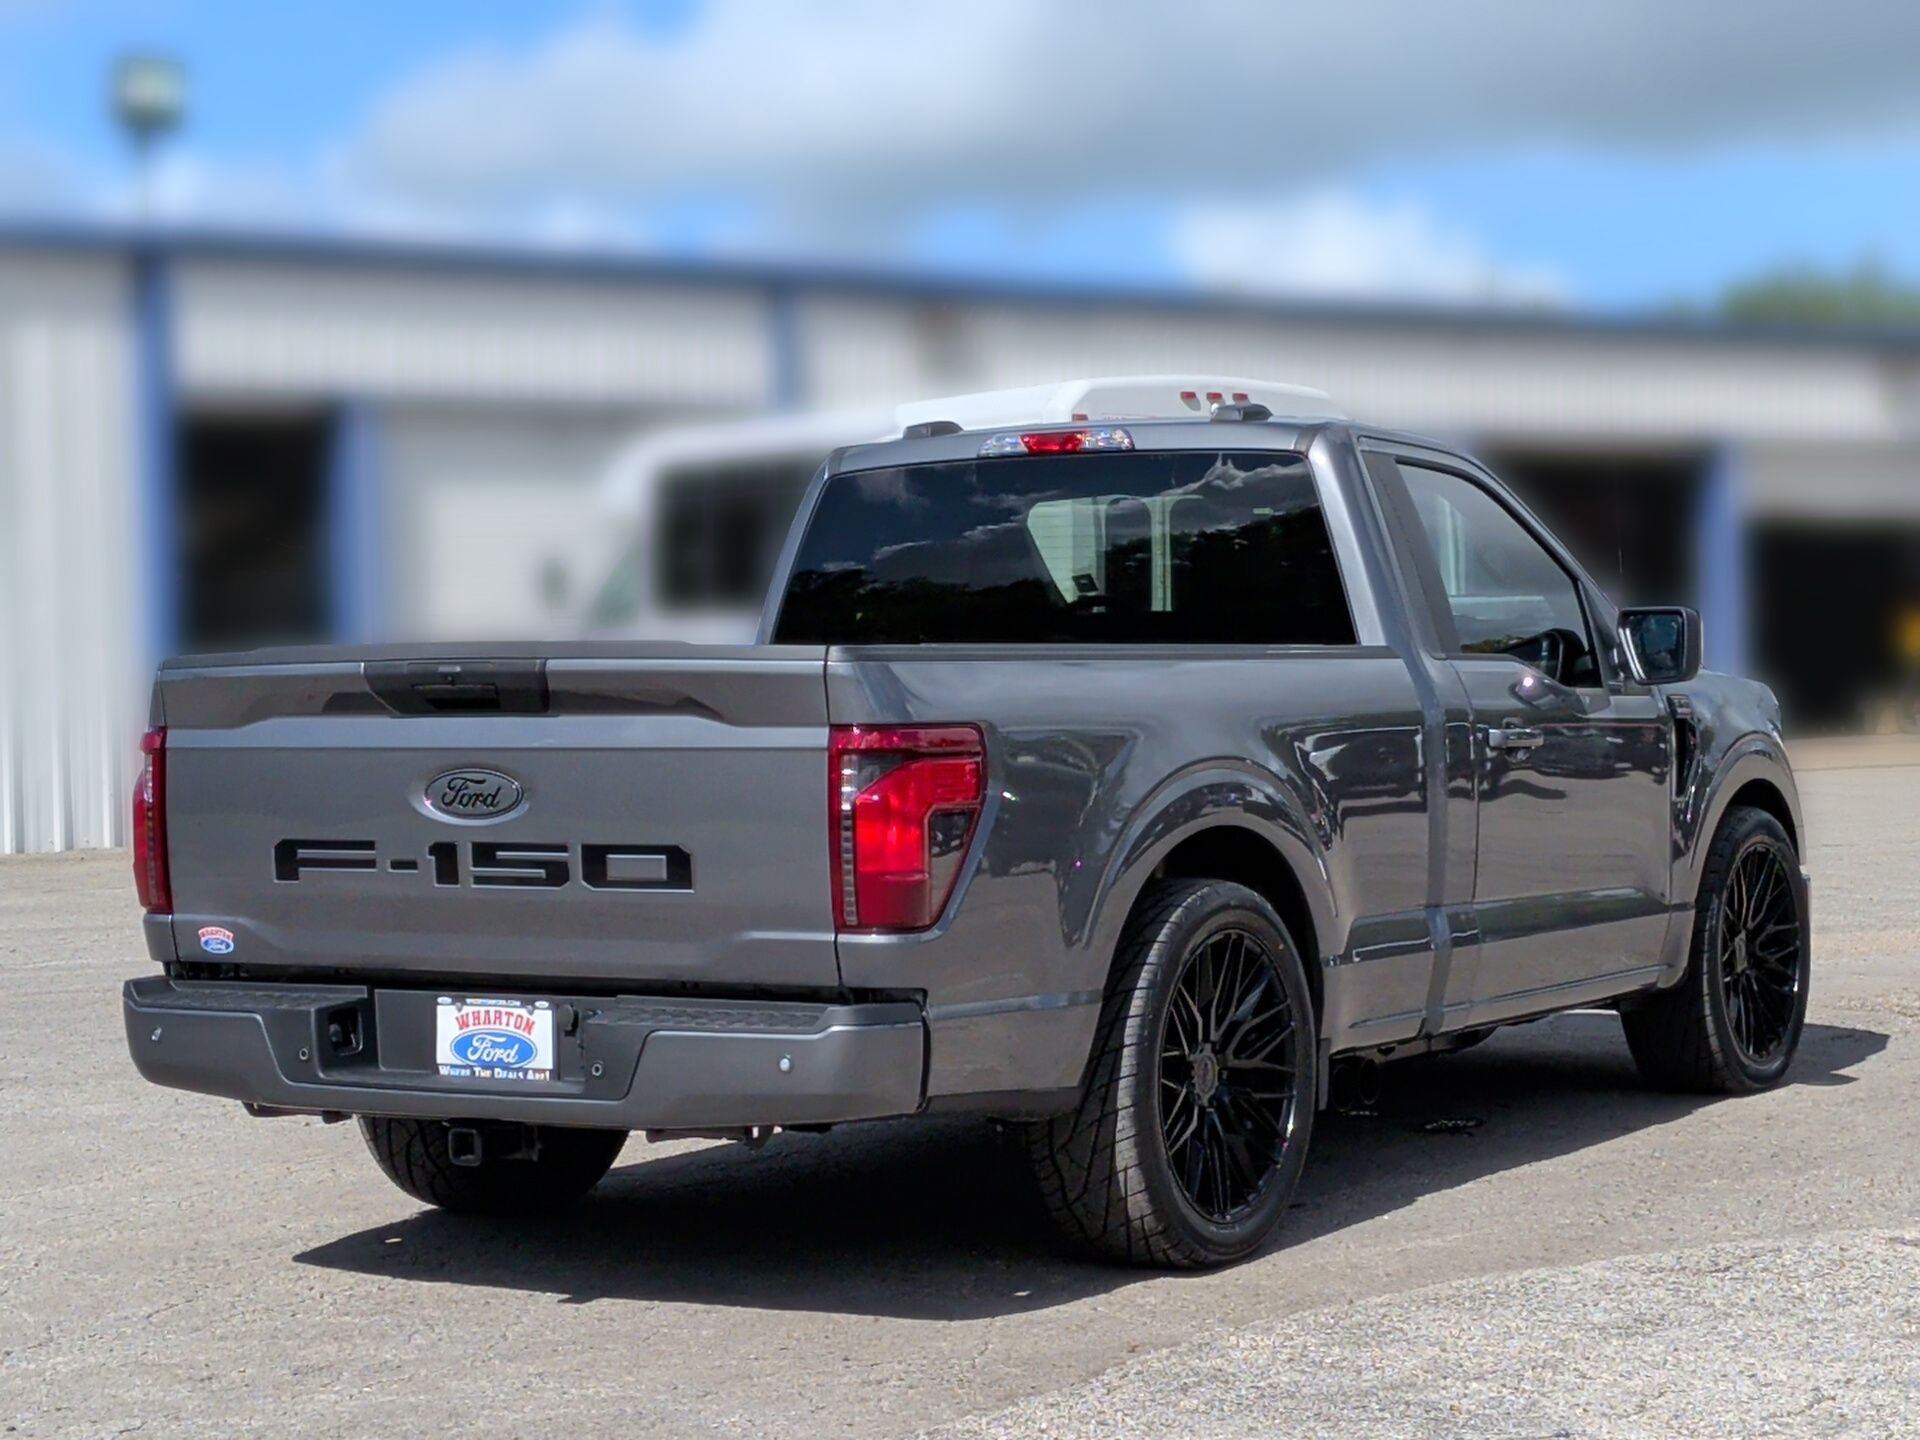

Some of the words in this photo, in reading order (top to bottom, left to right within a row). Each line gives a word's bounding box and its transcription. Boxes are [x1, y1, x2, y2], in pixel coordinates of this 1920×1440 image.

[441, 776, 502, 808] Ford
[274, 839, 695, 893] F-150
[455, 1009, 536, 1036] WHARTON
[467, 1034, 520, 1063] Ford
